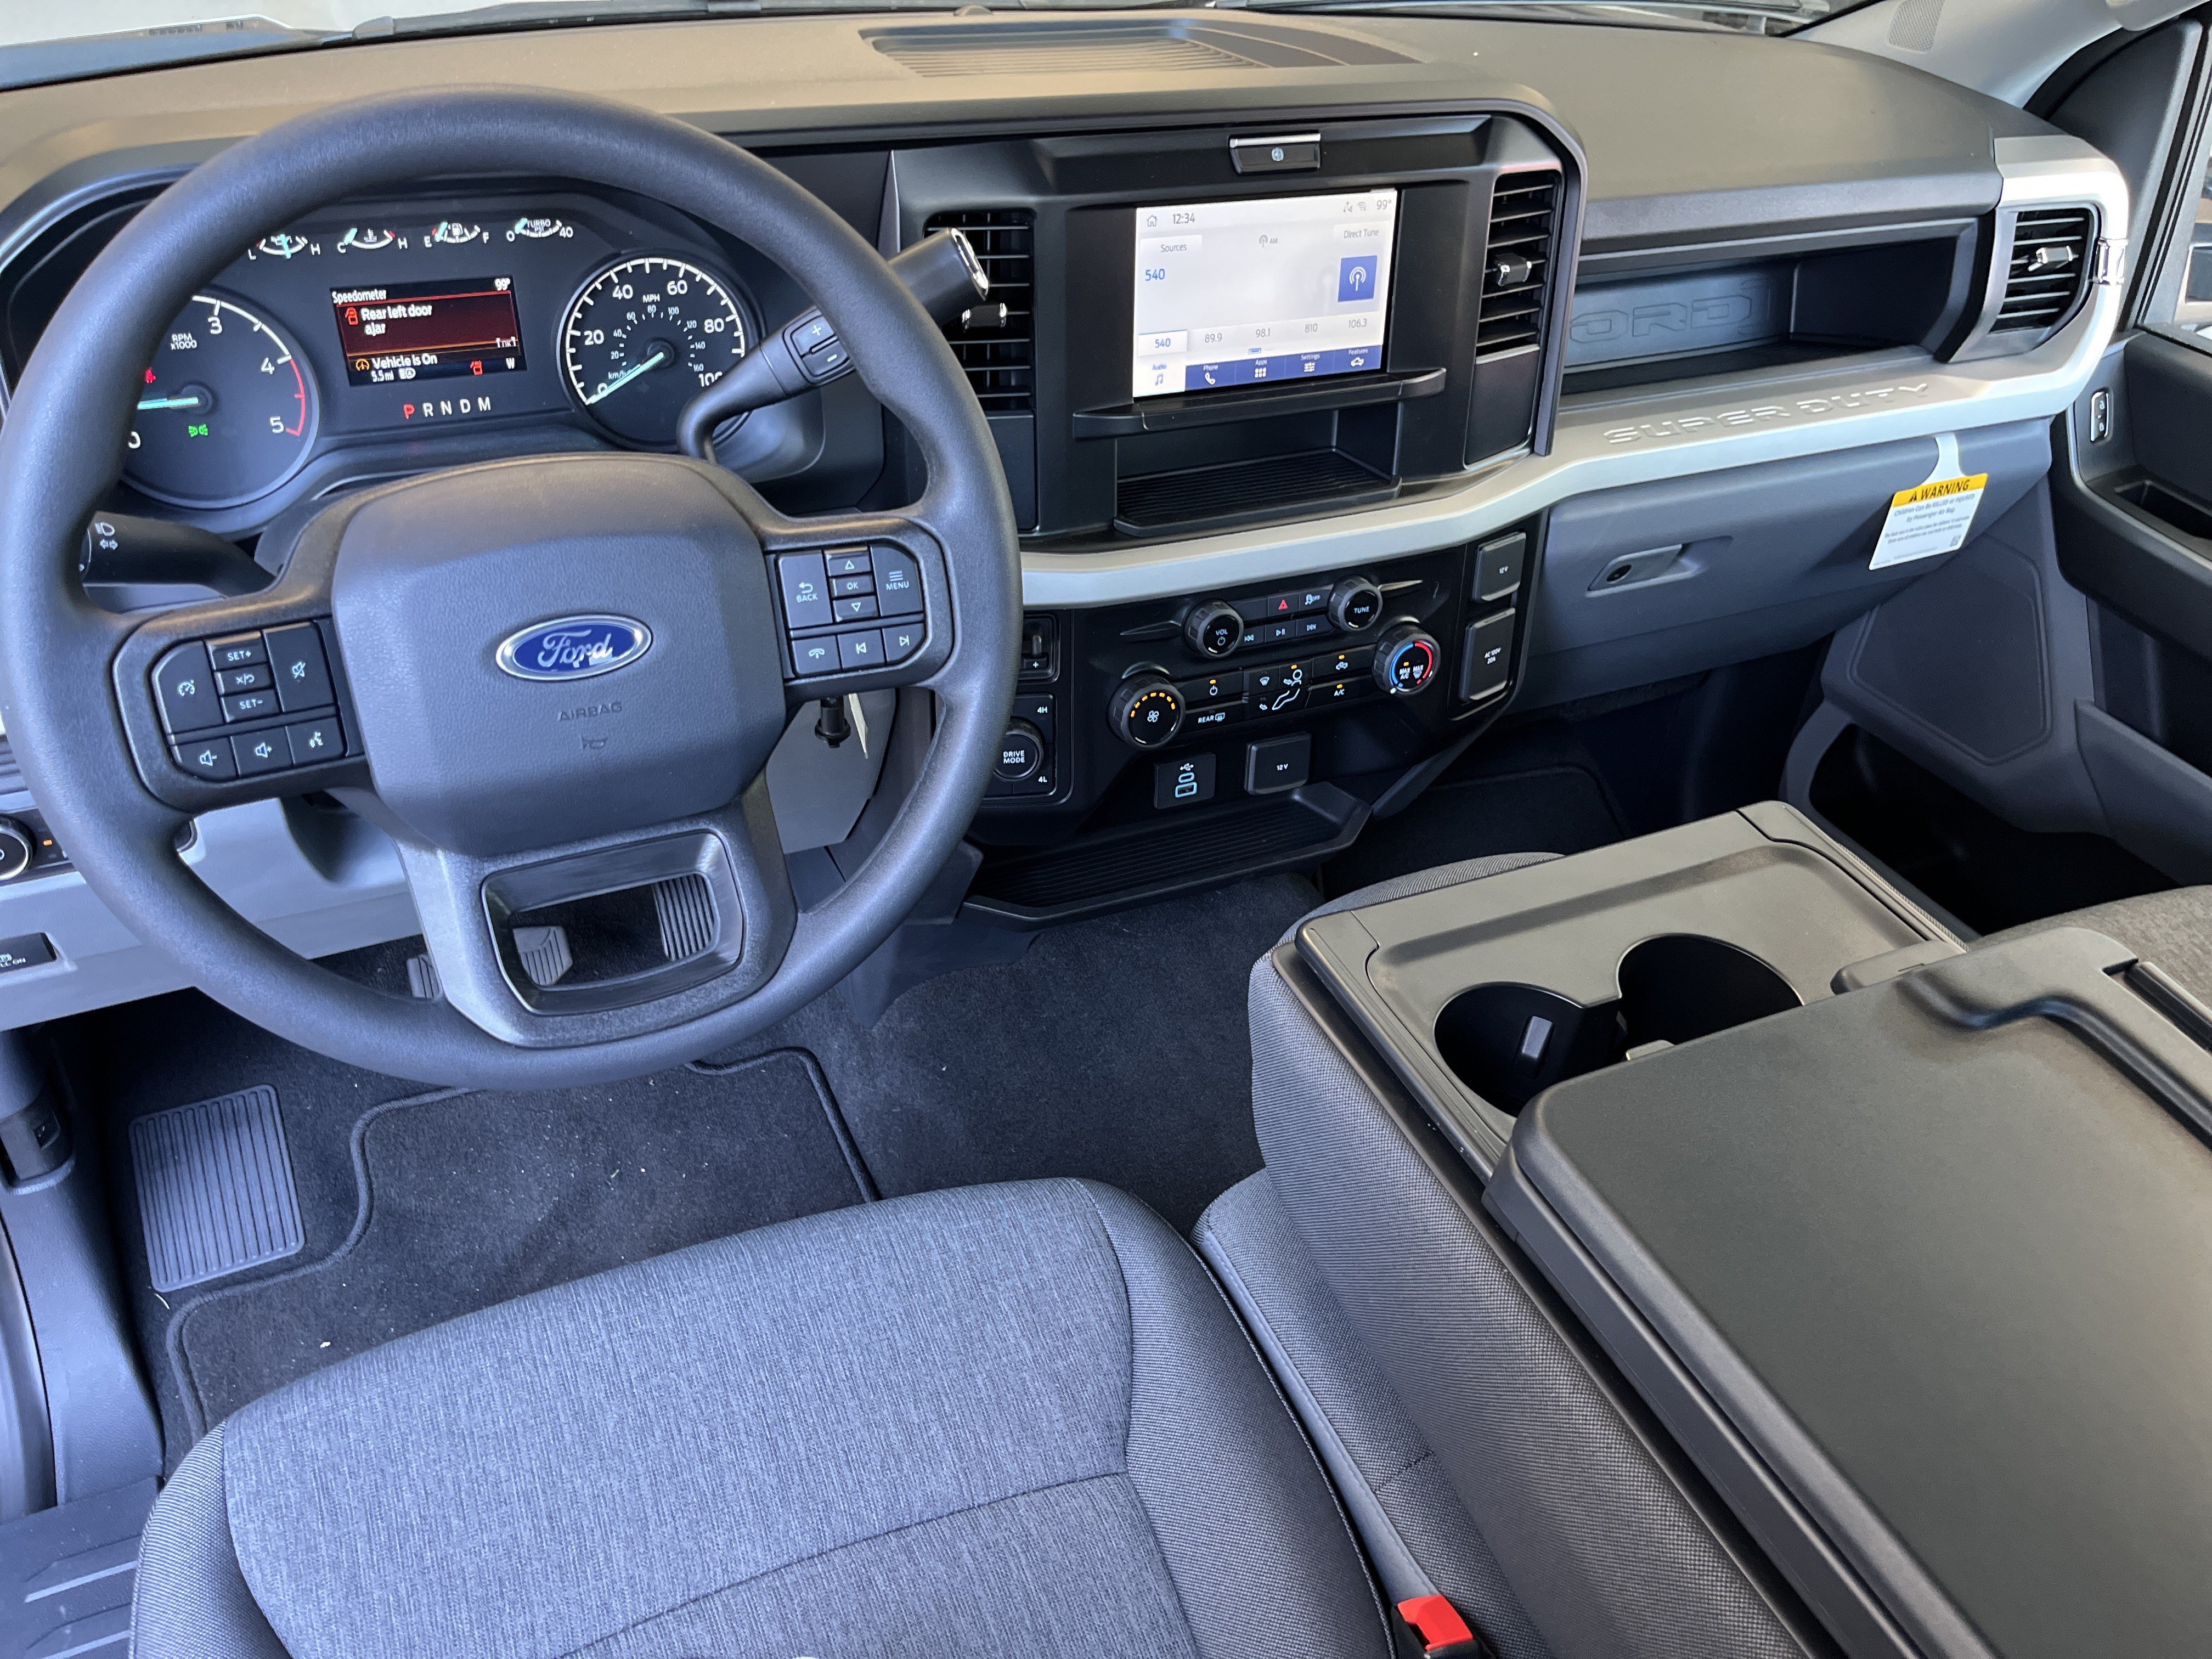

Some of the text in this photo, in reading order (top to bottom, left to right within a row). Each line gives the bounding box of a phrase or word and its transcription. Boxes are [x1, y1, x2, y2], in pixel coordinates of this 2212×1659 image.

[527, 219, 551, 228] TURBO
[1172, 212, 1195, 224] 12:34
[483, 232, 489, 244] F
[559, 227, 573, 238] 40
[1344, 228, 1379, 239] Direct Tune
[398, 238, 408, 249] H
[424, 235, 432, 247] E
[311, 243, 320, 256] H
[337, 242, 347, 253] C
[1160, 244, 1187, 253] Sources
[248, 249, 257, 261] L
[1145, 268, 1165, 282] 540
[612, 284, 633, 300] 40
[667, 280, 687, 295] 60
[332, 289, 387, 305] Speedometer
[643, 294, 660, 303] MPH
[361, 304, 432, 321] Rear left door
[647, 304, 656, 313] 80
[668, 306, 679, 315] 100
[627, 312, 635, 320] 60
[207, 316, 223, 335] 3
[365, 322, 386, 336] ajar
[687, 320, 697, 329] 120
[704, 318, 725, 334] 80
[172, 332, 193, 343] RPM
[584, 329, 604, 346] 20
[613, 329, 622, 337] 40
[1155, 318, 1367, 348] 540 89.9 98.1 810 106.3
[170, 339, 198, 351] x1000
[695, 341, 706, 349] 140
[372, 353, 438, 370] Vehicle Is On
[611, 351, 619, 360] 20
[261, 357, 275, 375] 4
[505, 357, 515, 370] W
[693, 363, 704, 373] 160
[403, 396, 491, 420] P R N D M
[1603, 382, 1928, 444] SUPER DUTY
[269, 416, 284, 433] 5
[1921, 479, 1970, 500] WARNING
[847, 582, 859, 590] OK
[886, 581, 910, 591] MENU
[797, 593, 819, 603] BACK
[1353, 605, 1370, 614] TUNE
[1215, 628, 1228, 636] VOL
[538, 628, 613, 668] Ford
[557, 701, 623, 721] AIRBAG
[1198, 715, 1214, 724] REAR
[1003, 749, 1025, 758] DRIVE
